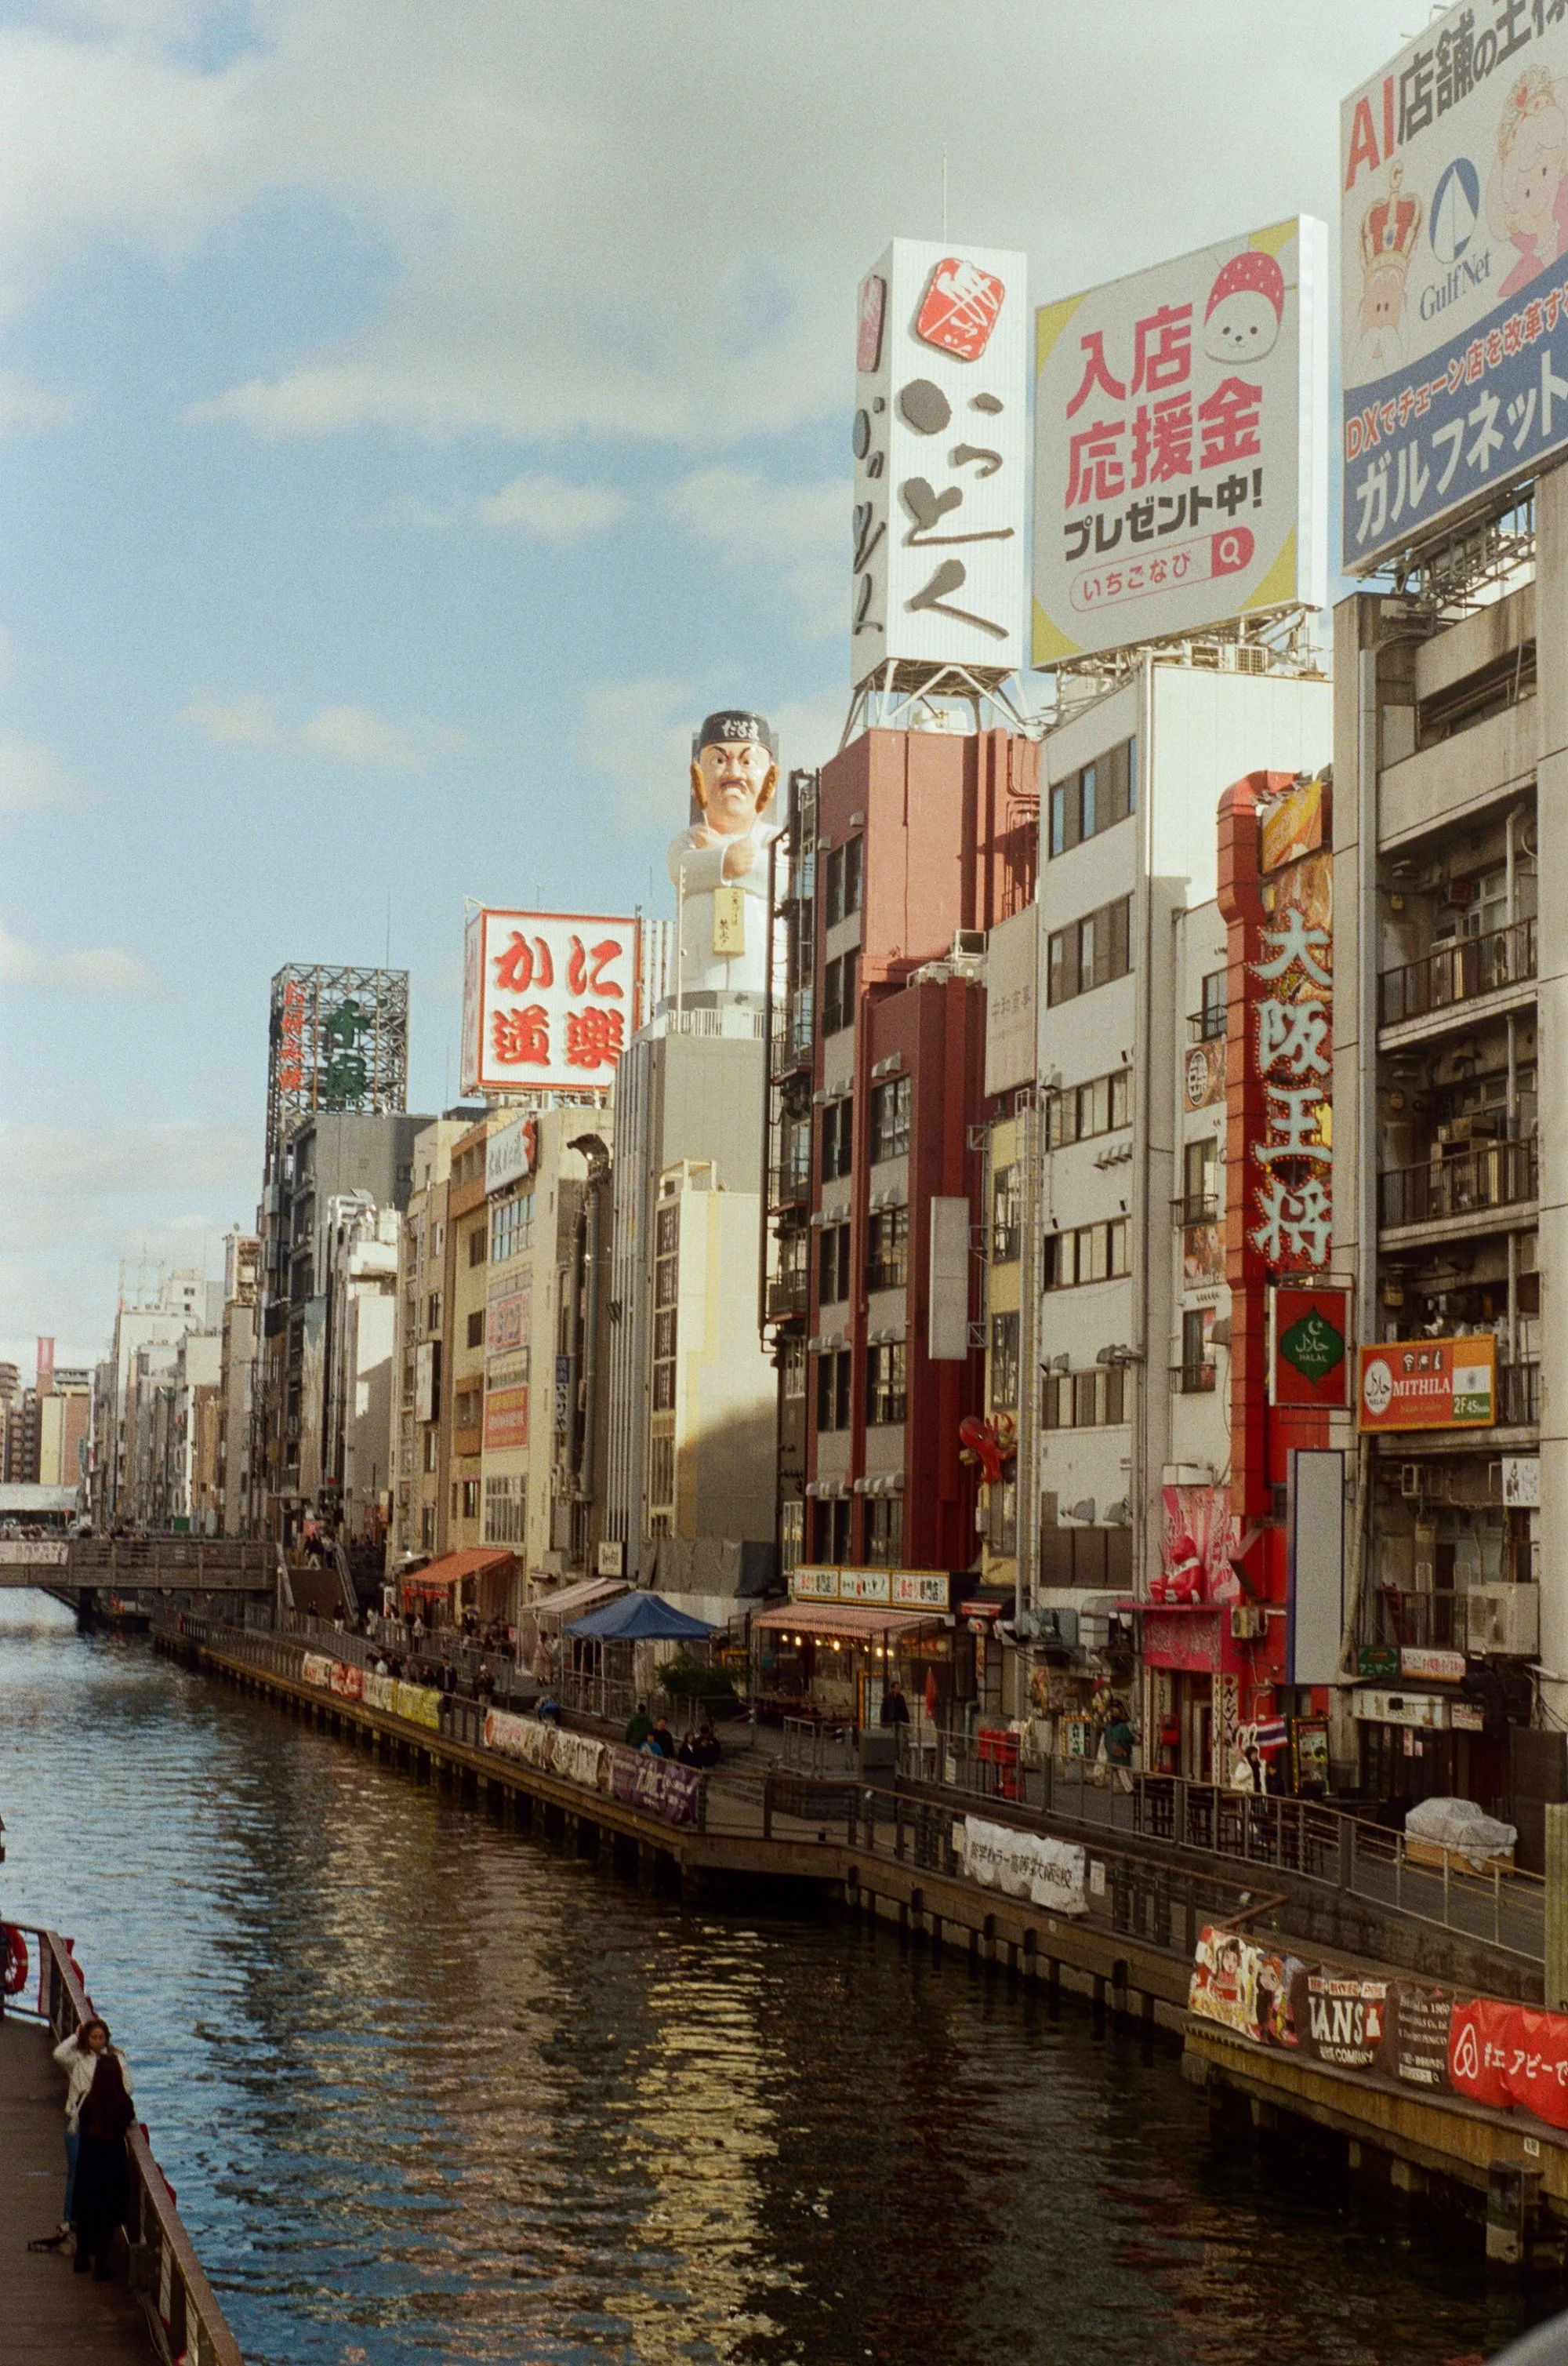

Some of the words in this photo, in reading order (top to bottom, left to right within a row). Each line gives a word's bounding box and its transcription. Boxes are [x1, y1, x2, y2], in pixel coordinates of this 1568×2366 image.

[1065, 303, 1192, 420] 入店
[1065, 376, 1262, 510] 応援金
[1355, 350, 1568, 544] ガルフネット
[1083, 551, 1192, 601] いちごなび
[722, 719, 760, 740] だるま
[493, 931, 624, 998] かに
[1254, 907, 1333, 1264] 大阪王将
[1299, 1354, 1327, 1362] HALAL
[1392, 1377, 1450, 1396] MITHILA
[1454, 1397, 1467, 1413] 2F
